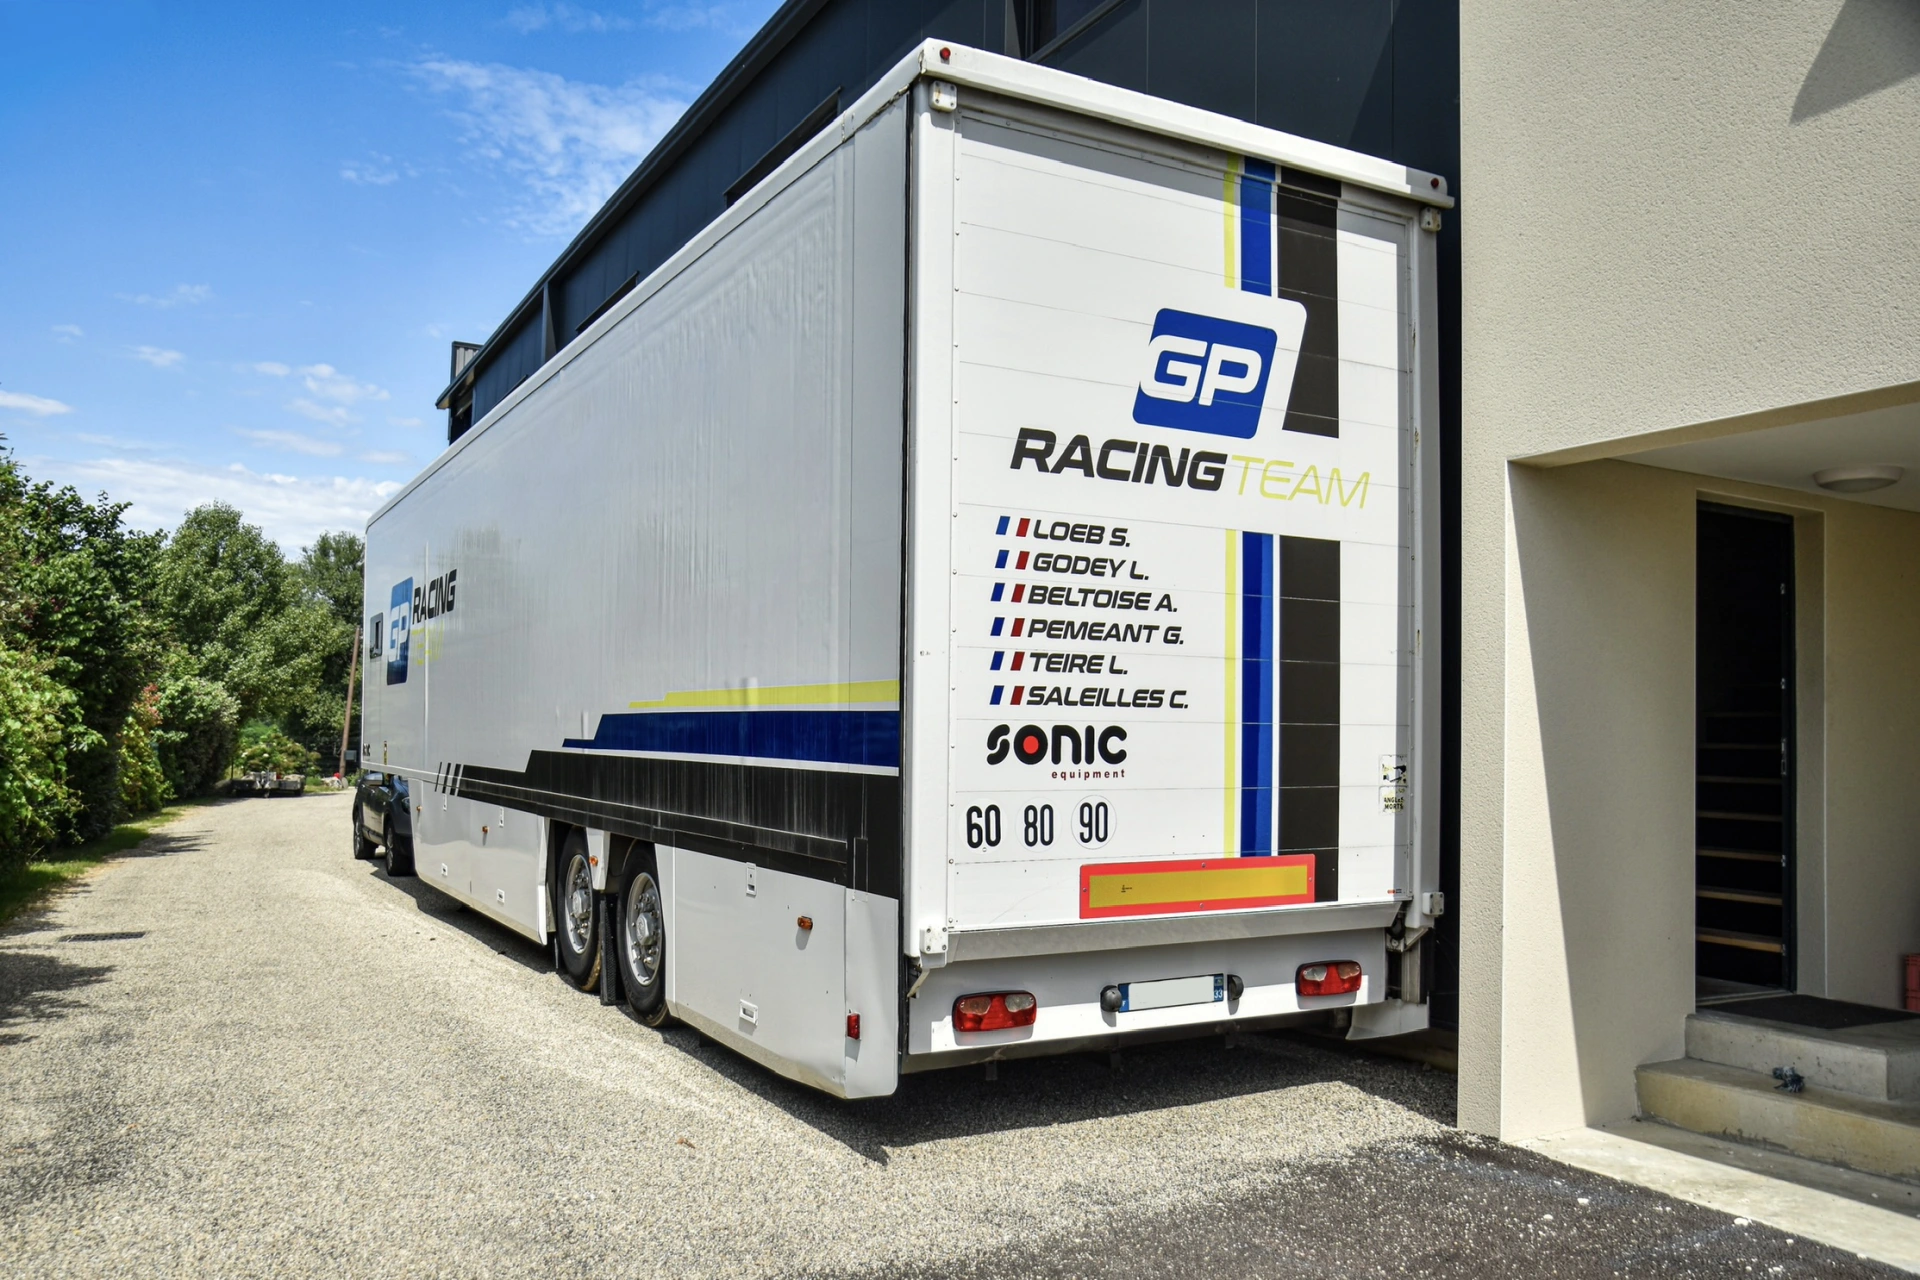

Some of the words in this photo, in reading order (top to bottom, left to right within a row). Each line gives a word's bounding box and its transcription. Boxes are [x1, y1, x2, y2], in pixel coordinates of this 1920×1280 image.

[1140, 333, 1262, 407] GP
[1010, 427, 1228, 492] RACING
[1231, 454, 1370, 509] TEAM
[1033, 519, 1104, 544] LOEB
[1109, 527, 1131, 547] S.
[1033, 552, 1126, 578] GODEY
[1129, 560, 1150, 580] L.
[412, 568, 457, 625] RACING
[1028, 585, 1152, 610] BELTOISE
[1155, 594, 1178, 612] A.
[388, 601, 410, 662] GP
[1028, 618, 1160, 644] PEMEANT
[1163, 626, 1185, 645] G.
[1029, 652, 1105, 674] TEIRE
[1109, 656, 1129, 675] L.
[1026, 686, 1164, 709] SALEILLES
[1169, 690, 1189, 709] C.
[1051, 769, 1126, 781] equipment
[966, 804, 1002, 849] 60
[1023, 803, 1054, 847] 80
[1079, 801, 1109, 844] 90
[1214, 989, 1223, 998] 33
